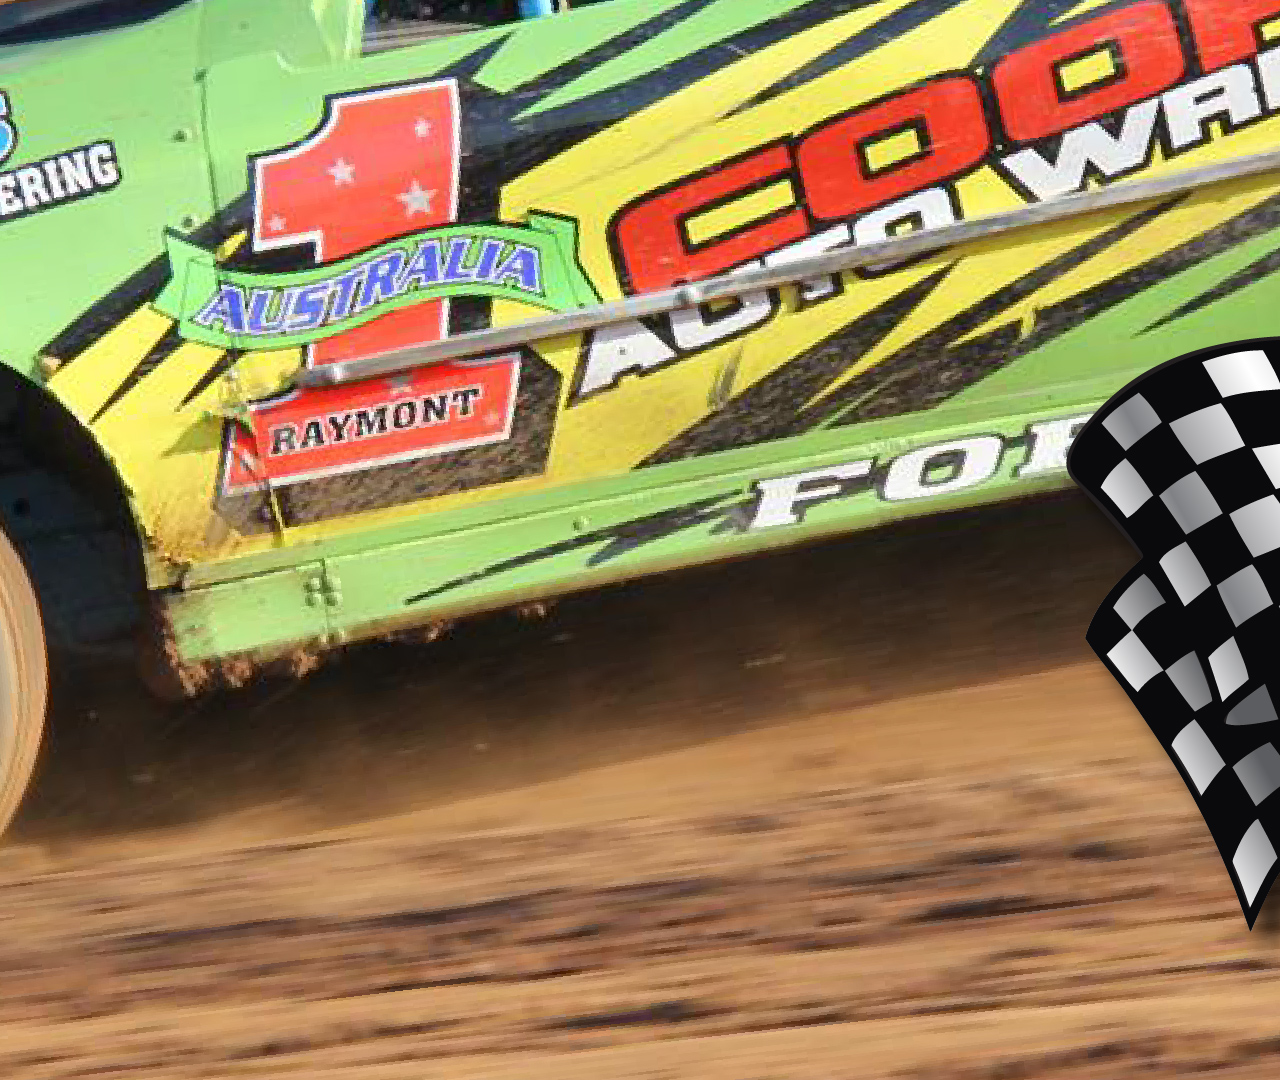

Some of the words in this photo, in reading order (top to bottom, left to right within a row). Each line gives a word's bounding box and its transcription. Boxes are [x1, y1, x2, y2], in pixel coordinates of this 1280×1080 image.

[189, 233, 546, 334] AUSTRALIA
[570, 185, 964, 404] AUTO
[270, 387, 482, 457] RAYMONT
